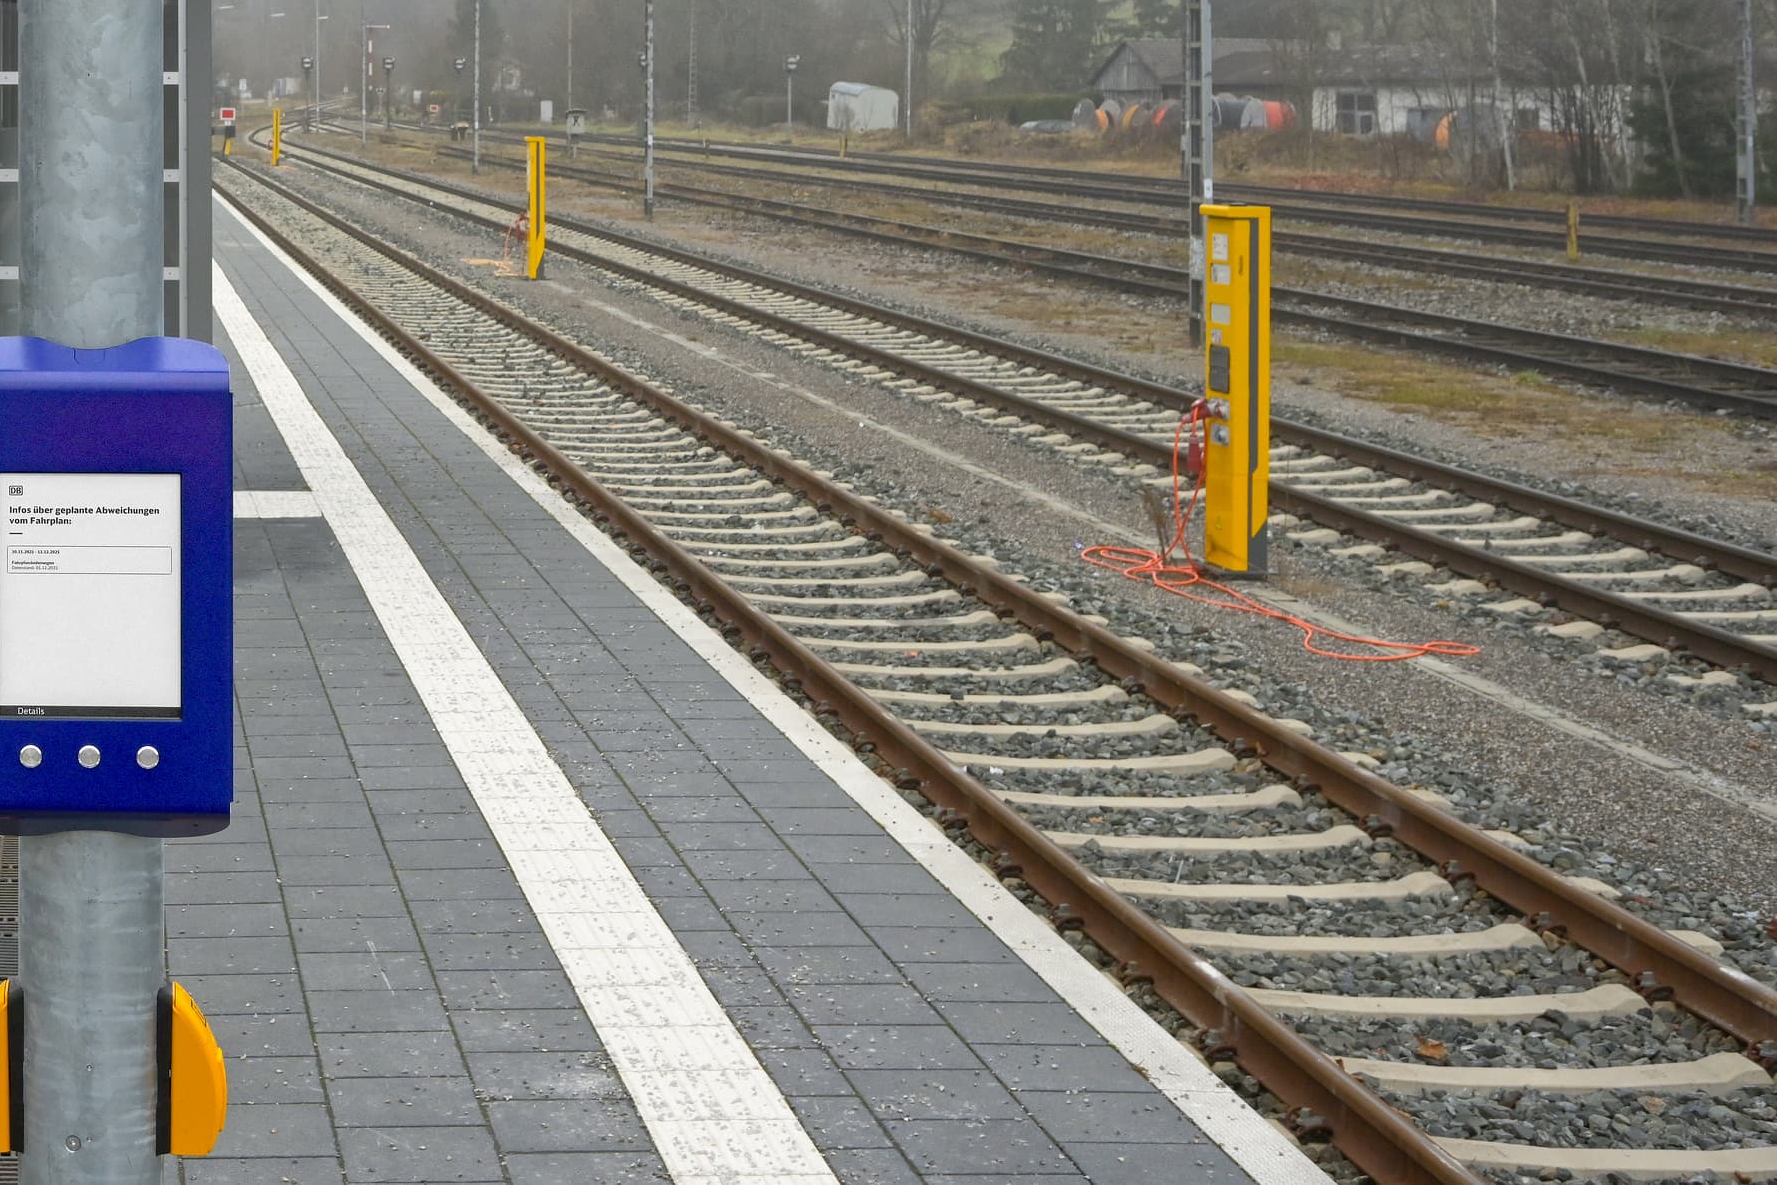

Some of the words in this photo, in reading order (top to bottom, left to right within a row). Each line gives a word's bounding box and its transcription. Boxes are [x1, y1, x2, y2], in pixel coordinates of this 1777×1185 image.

[9, 486, 23, 496] DB
[9, 506, 32, 514] Infos
[33, 506, 53, 514] über
[55, 506, 94, 516] geplante
[95, 506, 160, 516] Abweichungen
[30, 517, 72, 526] Fahrplan:
[17, 707, 45, 715] Details
